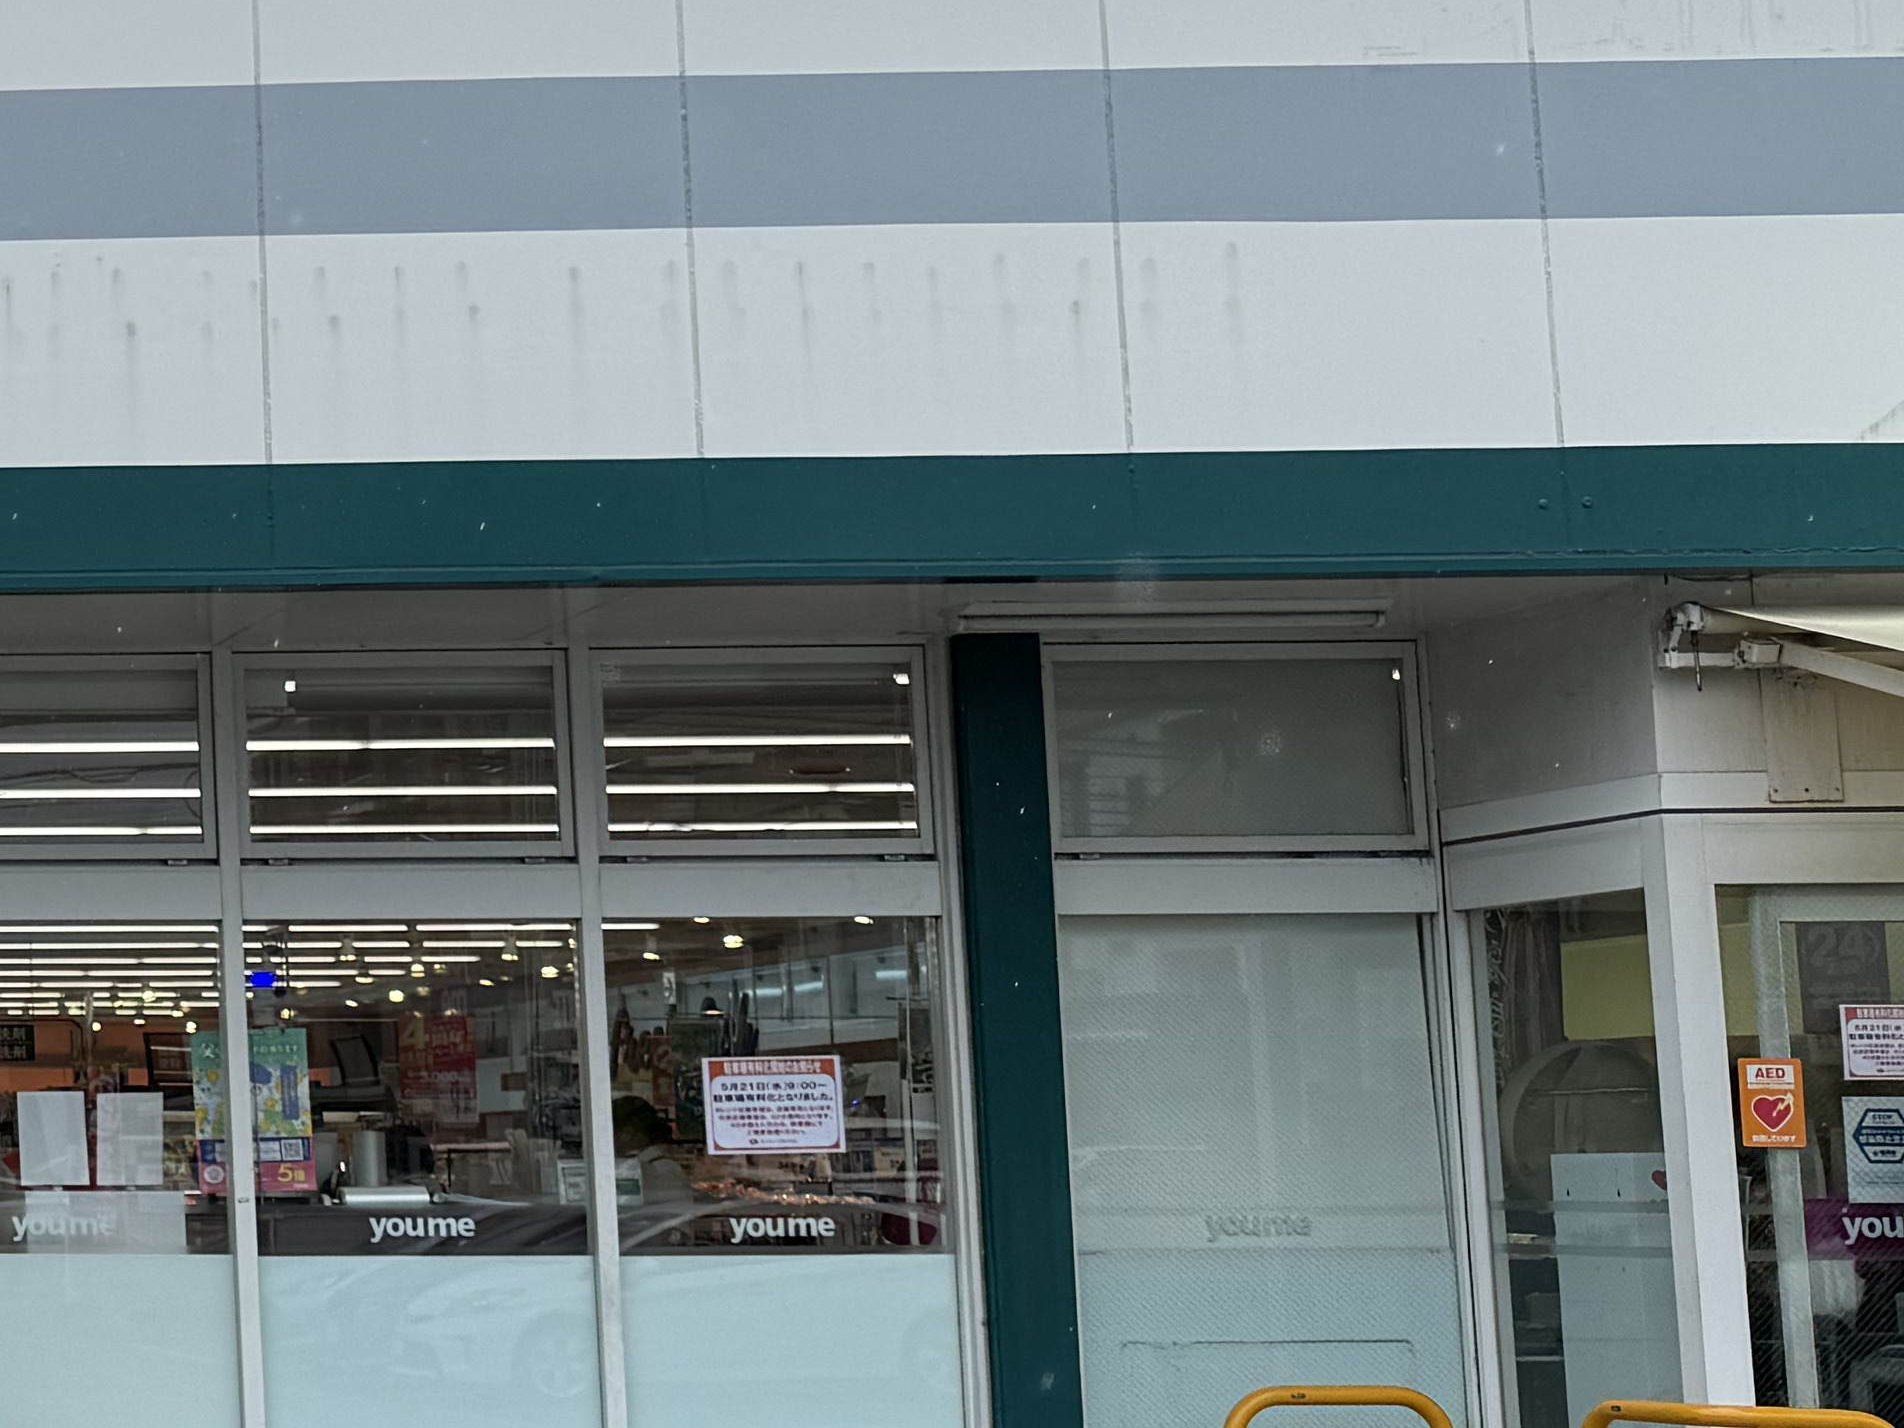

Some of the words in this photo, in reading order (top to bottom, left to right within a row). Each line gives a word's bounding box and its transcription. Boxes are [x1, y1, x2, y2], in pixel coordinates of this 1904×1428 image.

[1755, 1067, 1785, 1079] AED
[12, 1215, 116, 1242] youme
[369, 1213, 476, 1243] youme
[729, 1215, 836, 1243] youme
